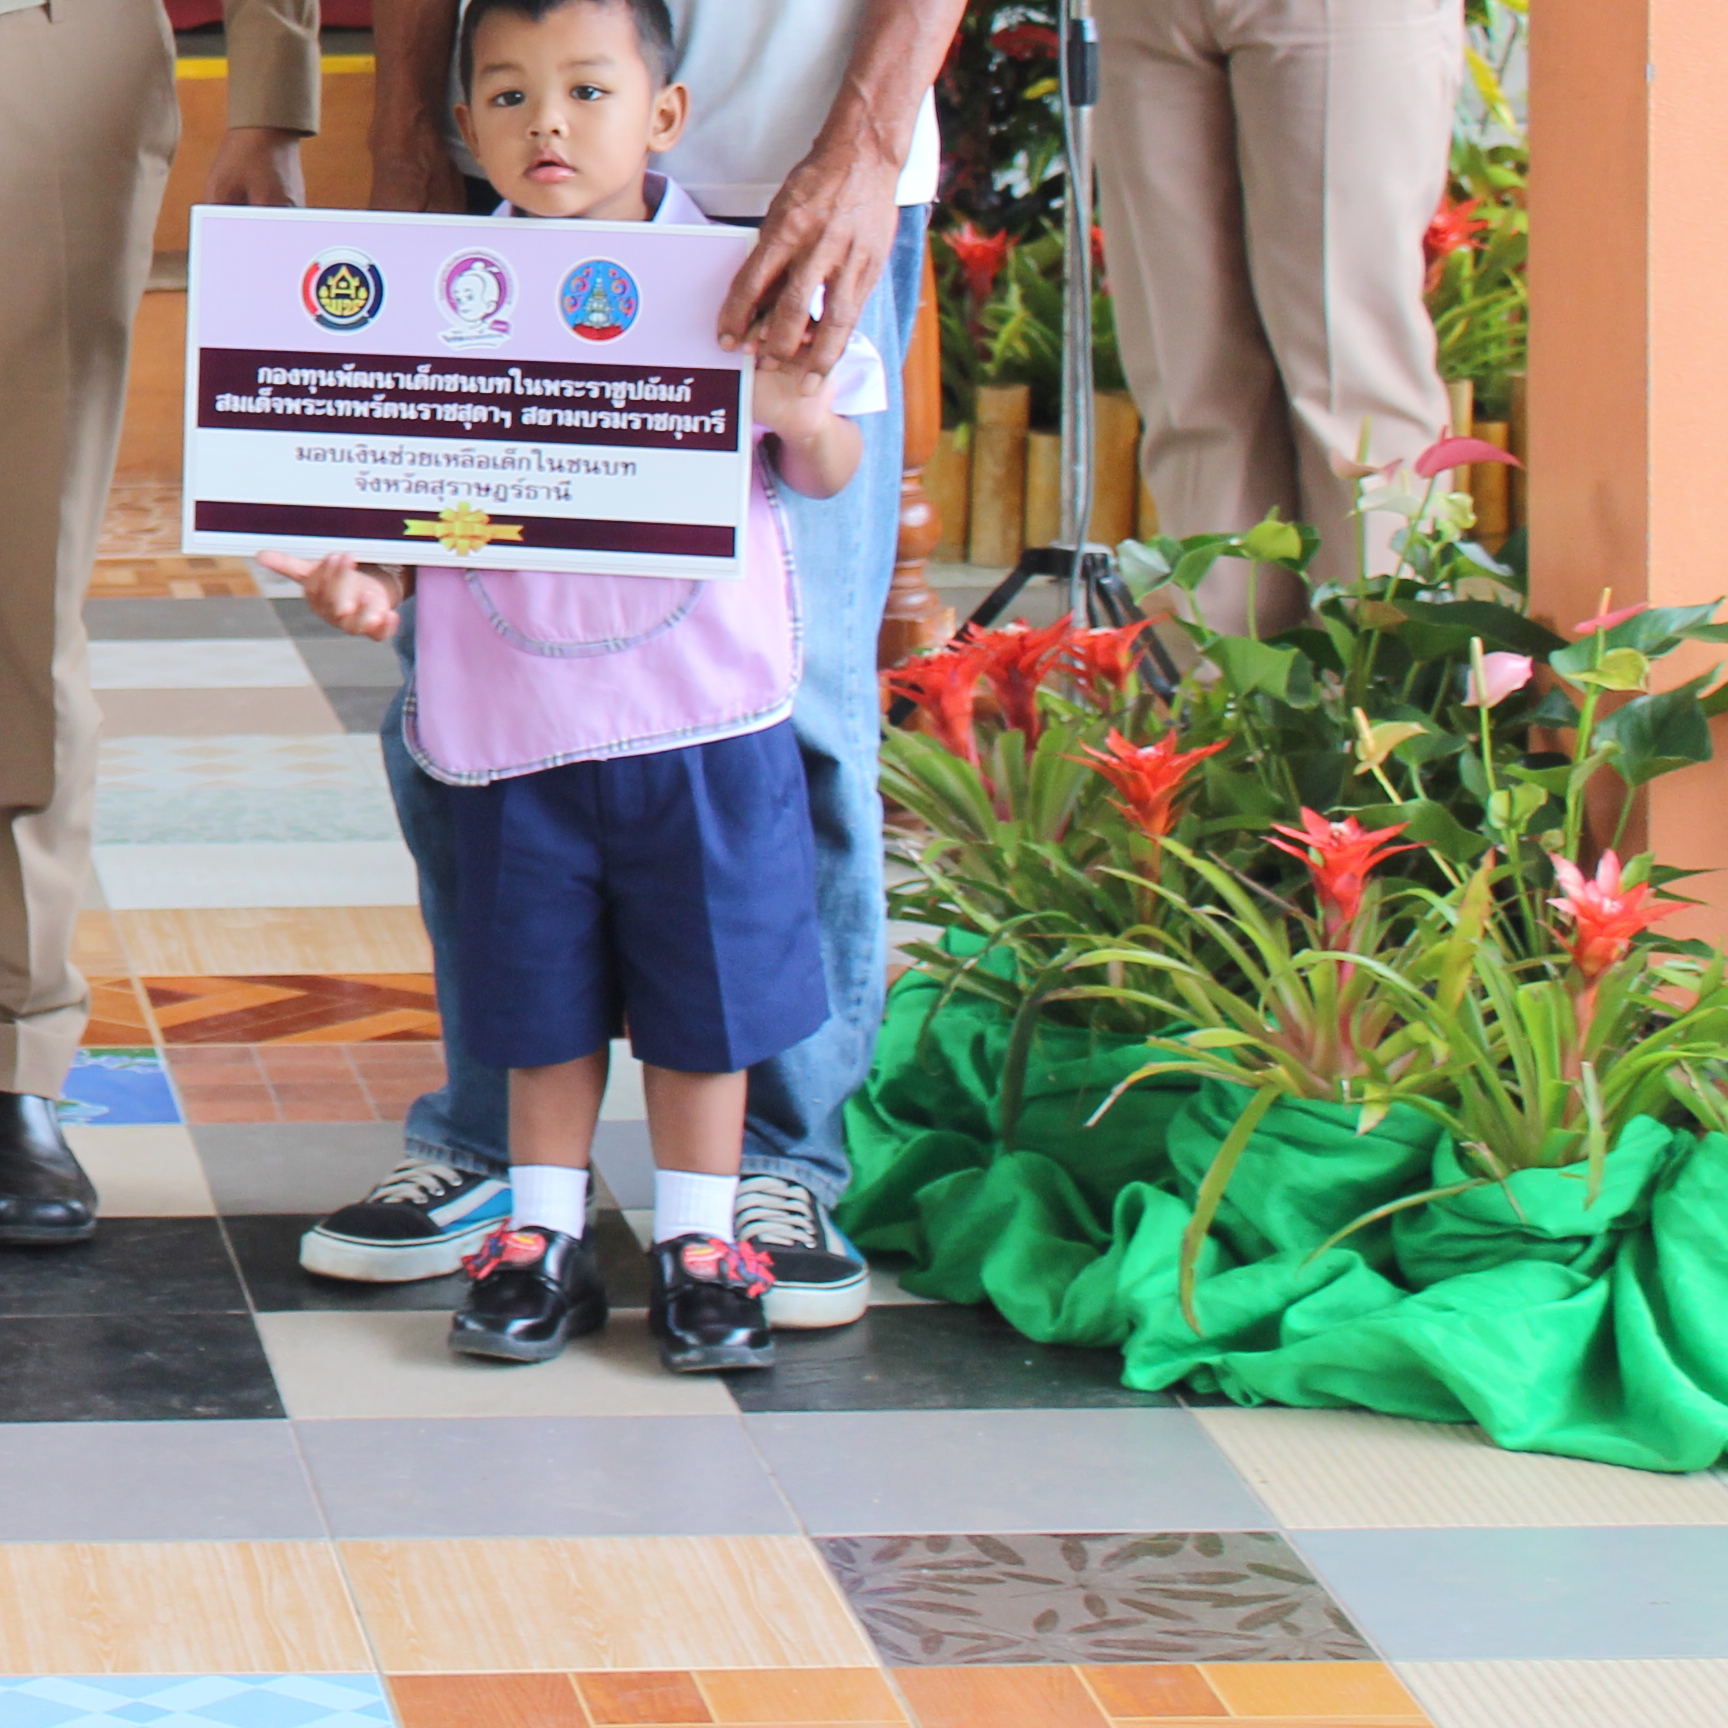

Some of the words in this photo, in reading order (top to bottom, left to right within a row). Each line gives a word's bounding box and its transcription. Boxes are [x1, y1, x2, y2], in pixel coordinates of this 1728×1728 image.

[256, 364, 693, 409] กองทุนพัฒนาเด็กชนบทในพระราชูปถัมภ์
[521, 405, 726, 440] สยามบรมราชกุมารี
[295, 444, 637, 476] มอบเงินช่วยเหลือเด็กในชนบท
[354, 473, 573, 503] จังหวัดสุราษฎร์ธานี
